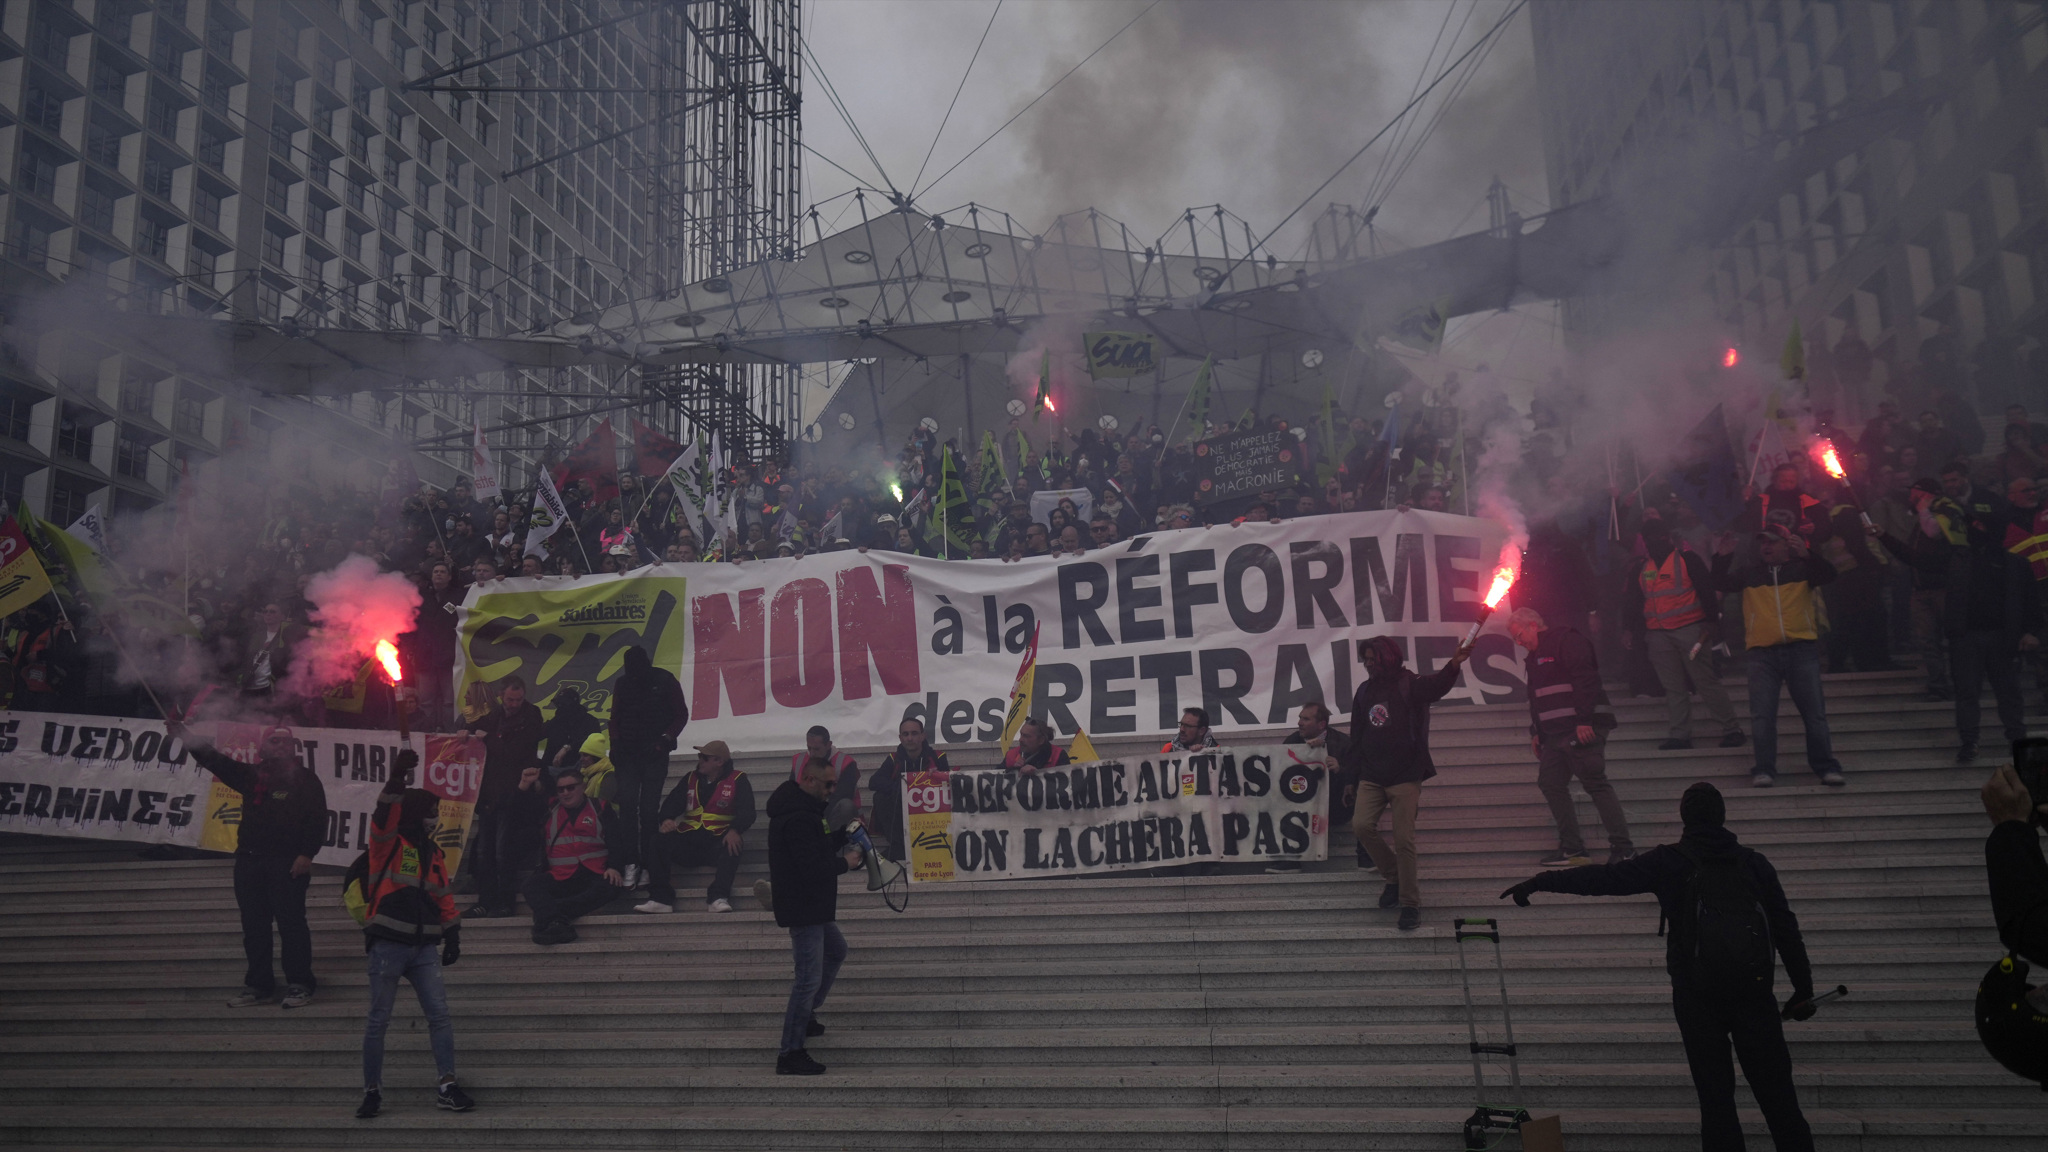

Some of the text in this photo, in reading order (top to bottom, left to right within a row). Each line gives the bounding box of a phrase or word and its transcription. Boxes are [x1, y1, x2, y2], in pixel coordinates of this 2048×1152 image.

[1209, 444, 1225, 456] NE
[1216, 452, 1242, 465] PLUS
[558, 600, 646, 622] Solidaires
[691, 532, 1483, 721] NON à la RÉFORME
[902, 633, 1529, 744] des RETRAIES
[334, 742, 415, 786] PARI
[428, 757, 480, 797] cgt
[950, 761, 1126, 813] REFORME
[1134, 759, 1182, 803] AU
[1189, 754, 1271, 797] TAS
[908, 781, 952, 812] cgt
[955, 829, 1008, 872] ON
[1023, 812, 1212, 870] LACHERA
[1222, 810, 1310, 855] PAS
[939, 870, 954, 878] Lyon
